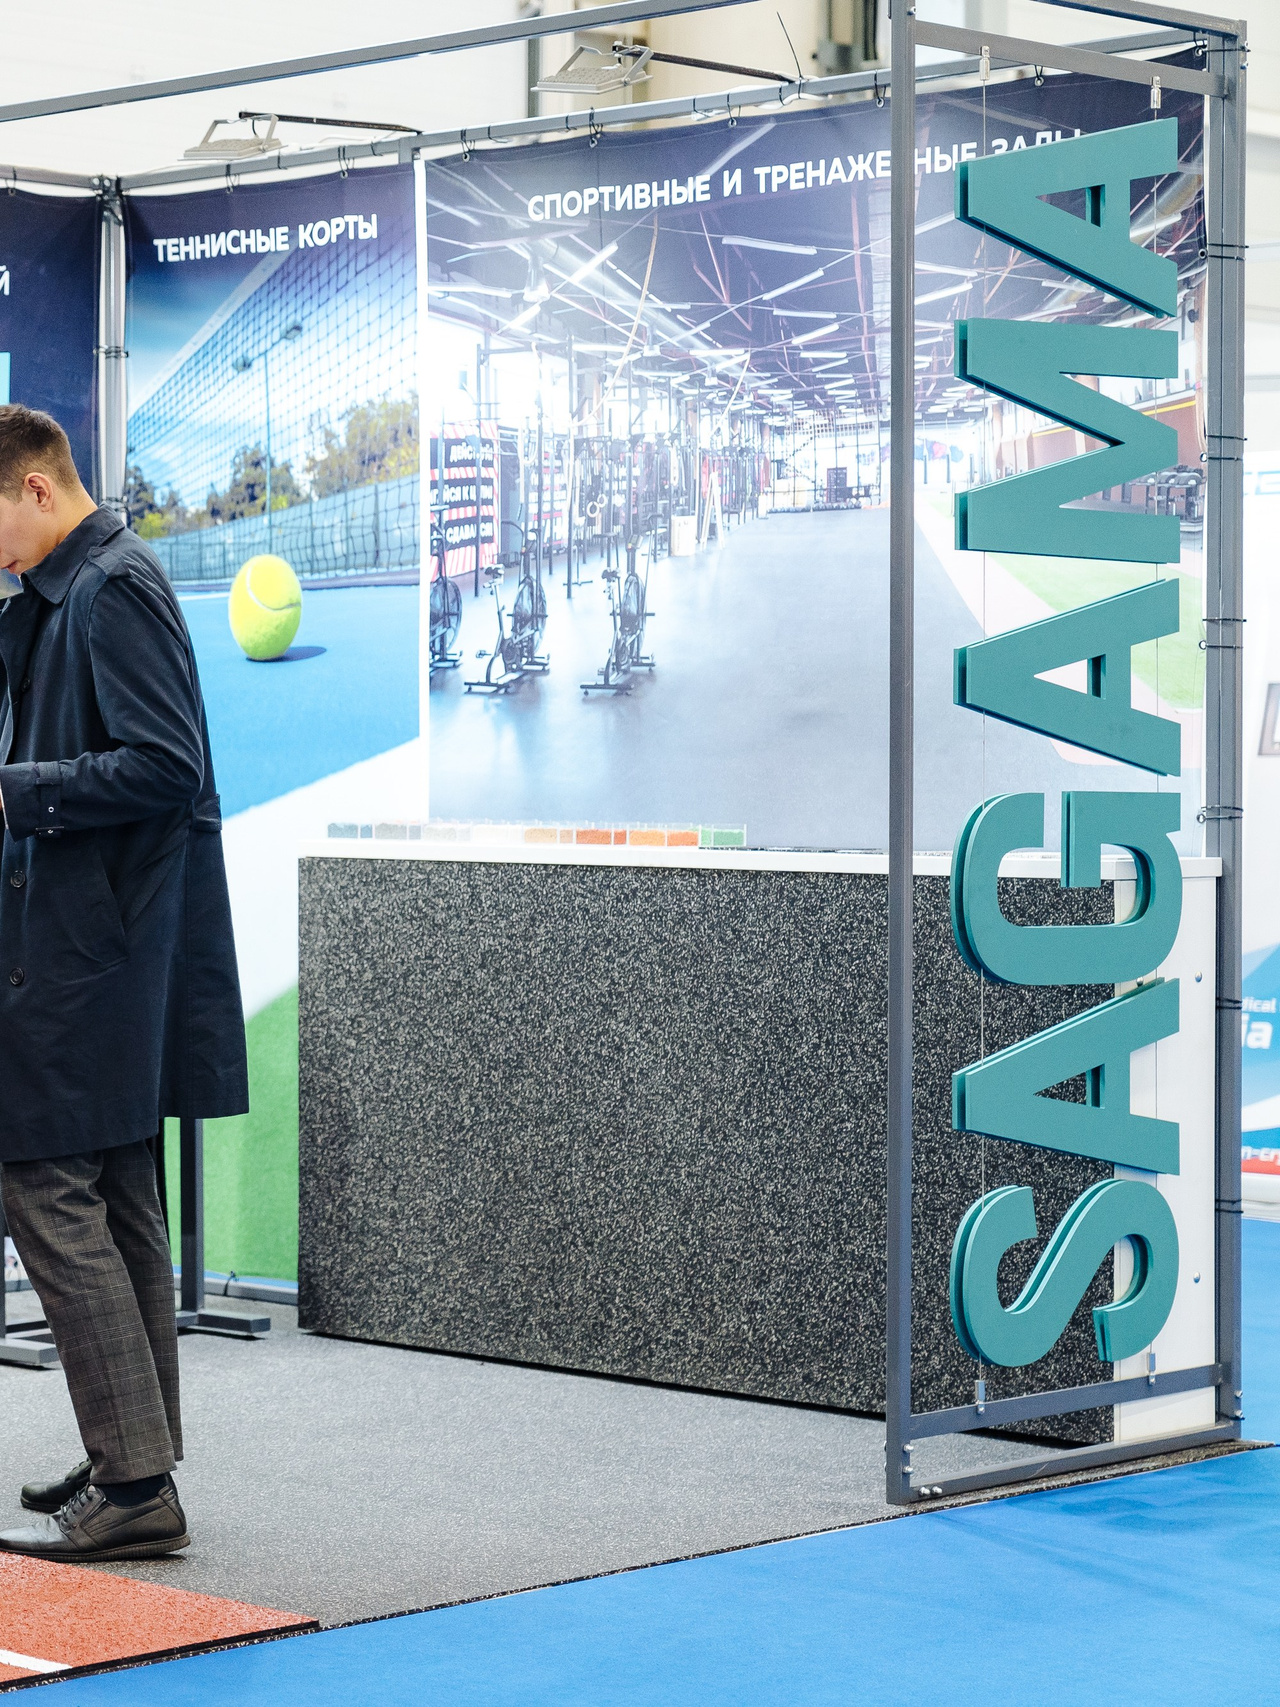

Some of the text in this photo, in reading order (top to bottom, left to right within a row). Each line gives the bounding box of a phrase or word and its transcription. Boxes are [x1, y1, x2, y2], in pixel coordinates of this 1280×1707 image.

[527, 174, 711, 222] СПОРТИВНЫЕ
[723, 168, 742, 198] И
[754, 141, 978, 194] ТРЕНАЖЕНЫЕ
[153, 213, 378, 262] ТЕННИСНЫЕ КОРТЫ
[950, 116, 1182, 1367] SAGAMA
